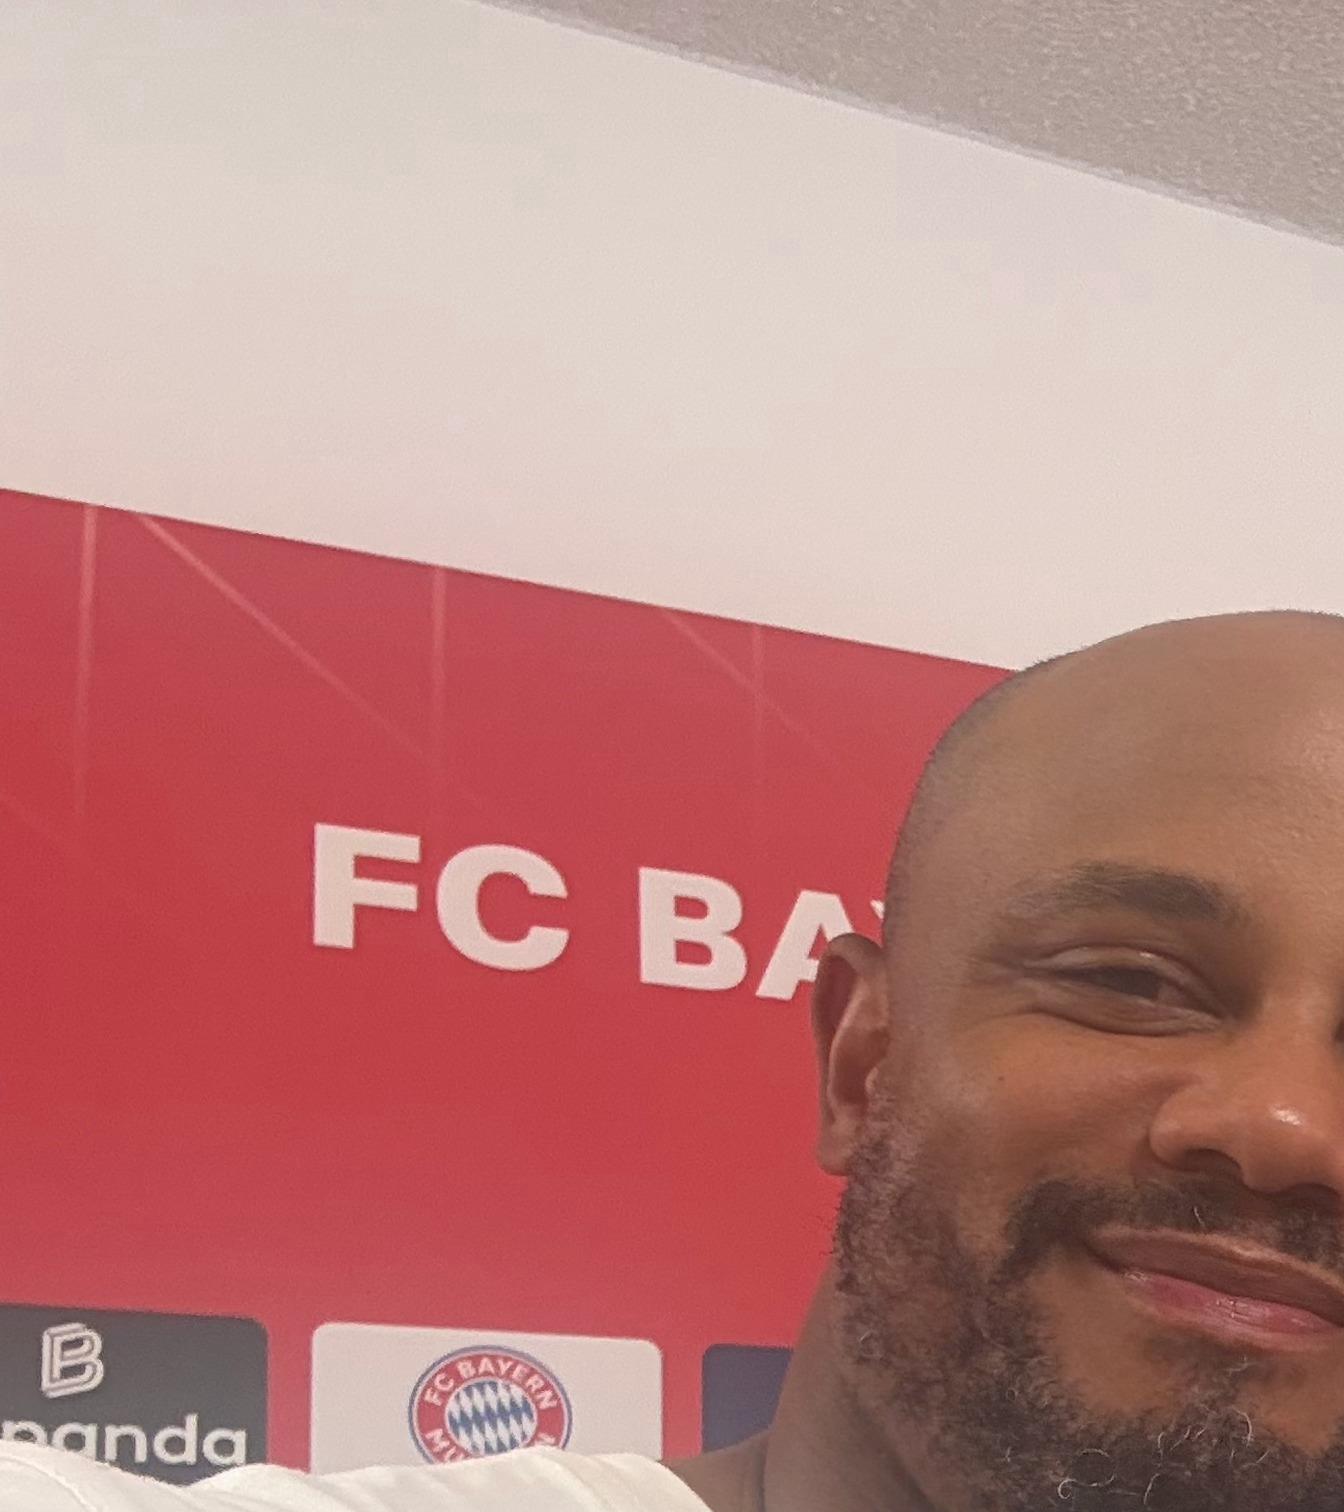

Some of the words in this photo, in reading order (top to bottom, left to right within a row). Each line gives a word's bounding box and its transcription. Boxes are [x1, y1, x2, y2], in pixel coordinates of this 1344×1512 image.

[312, 822, 571, 973] FC
[637, 865, 885, 1001] BA
[455, 1356, 559, 1410] BAYERN
